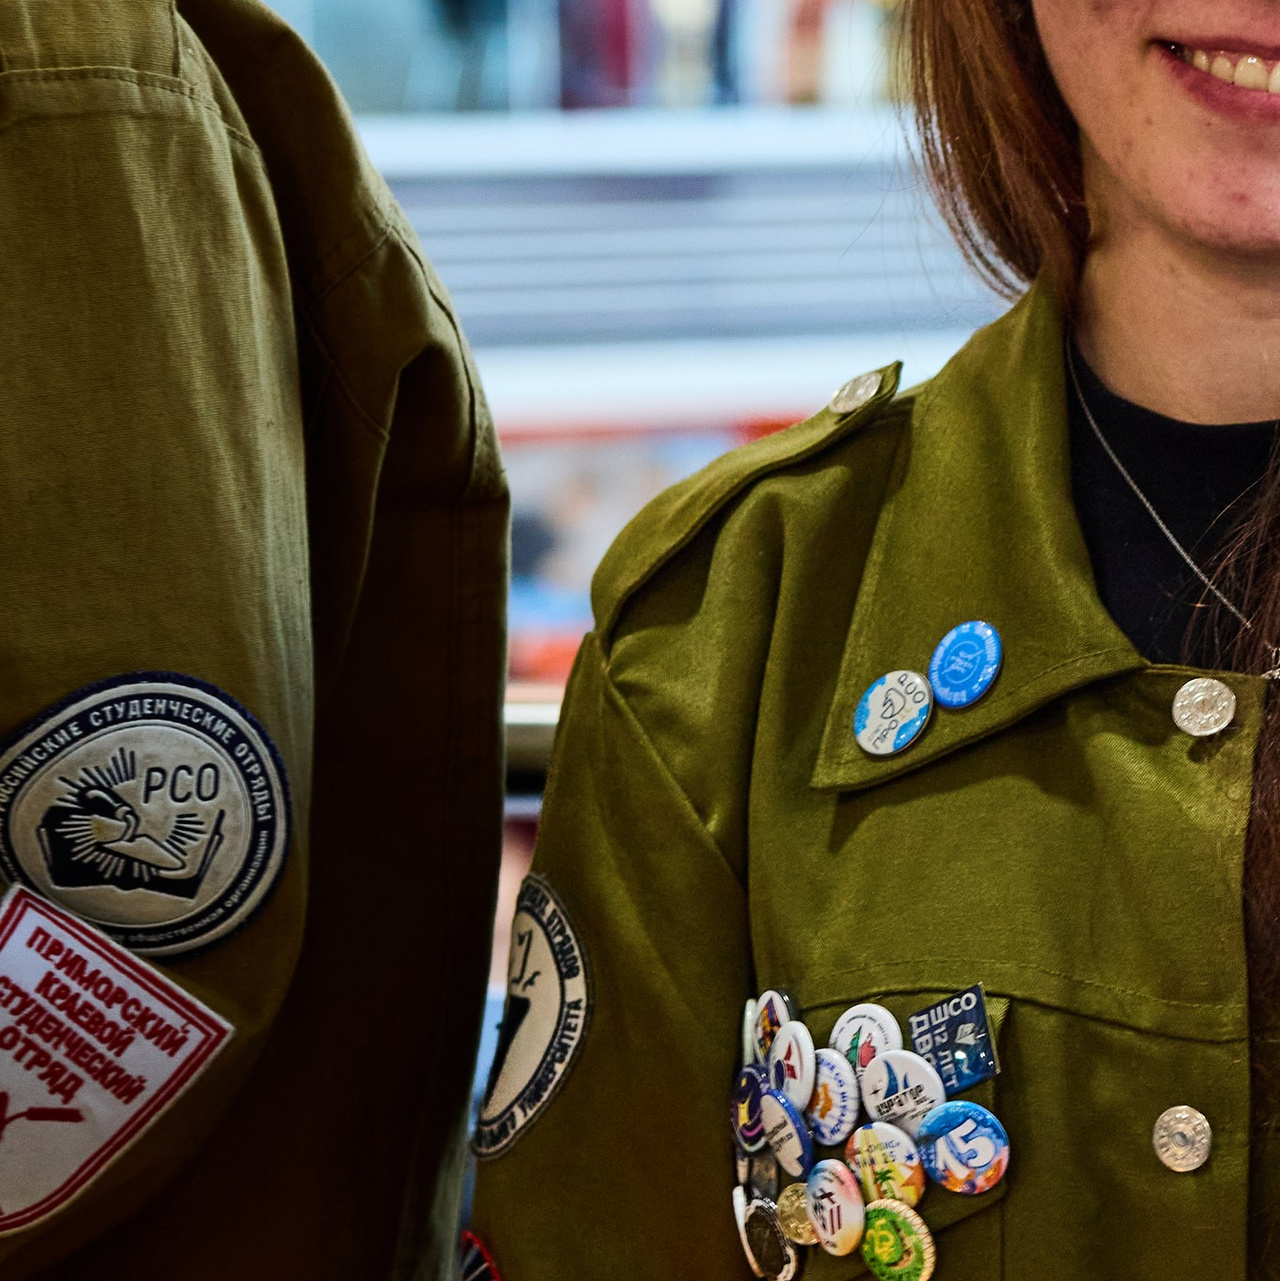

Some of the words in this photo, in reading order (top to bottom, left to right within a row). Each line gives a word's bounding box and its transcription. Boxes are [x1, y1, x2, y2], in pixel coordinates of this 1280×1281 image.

[0, 720, 84, 813] ОССИЙСКИЕ
[89, 697, 237, 745] СТУДЕНЧЕСКИЕ
[233, 739, 273, 821] ОТРЯДЫ
[142, 763, 220, 805] РСО
[26, 926, 190, 1057] ПРИМОРСКИЙ
[35, 970, 136, 1057] КРАЕВОЙ
[0, 1026, 84, 1105] ОТРЯД
[935, 1118, 996, 1180] 15
